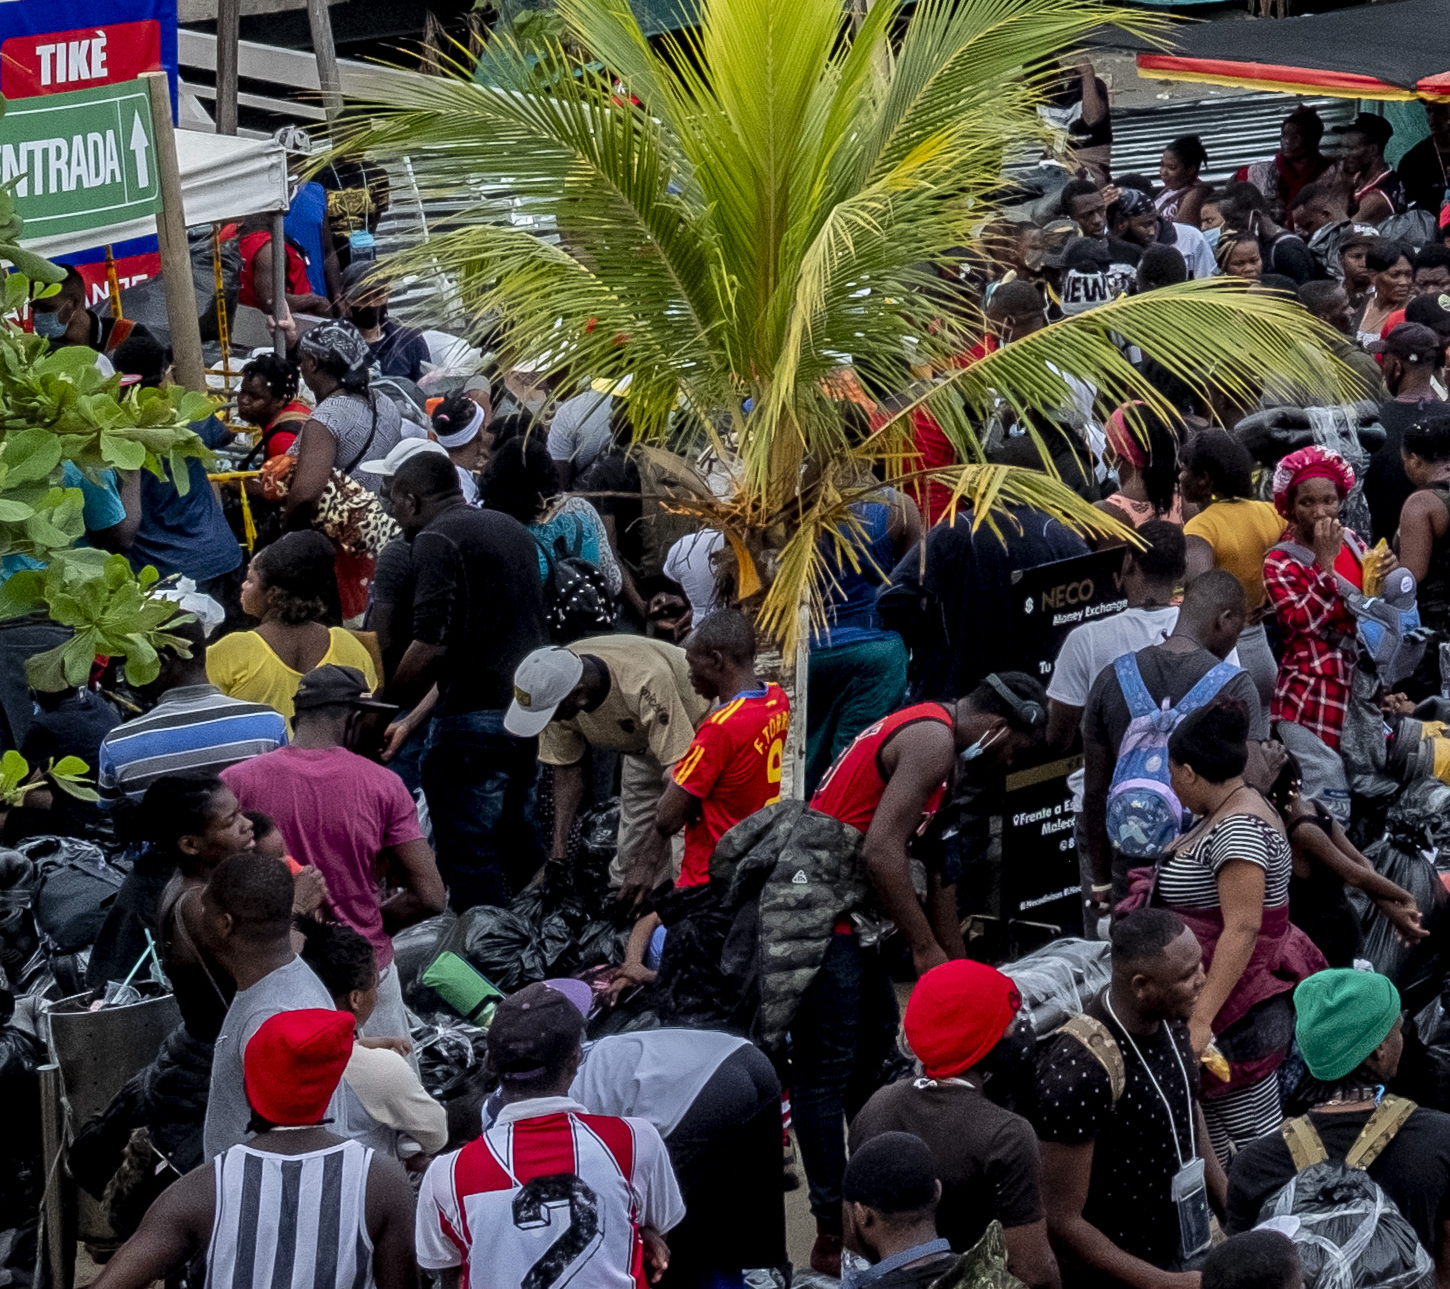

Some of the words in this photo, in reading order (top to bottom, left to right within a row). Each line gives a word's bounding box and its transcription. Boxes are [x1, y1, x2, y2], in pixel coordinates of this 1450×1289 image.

[35, 29, 108, 86] TIKÈ
[0, 129, 122, 198] NTRADA
[1041, 578, 1095, 612] NECO
[1052, 609, 1084, 626] Money
[1085, 599, 1128, 618] Exchange
[1020, 807, 1052, 825] Frente
[1054, 804, 1062, 815] a
[511, 1172, 606, 1289] 2
